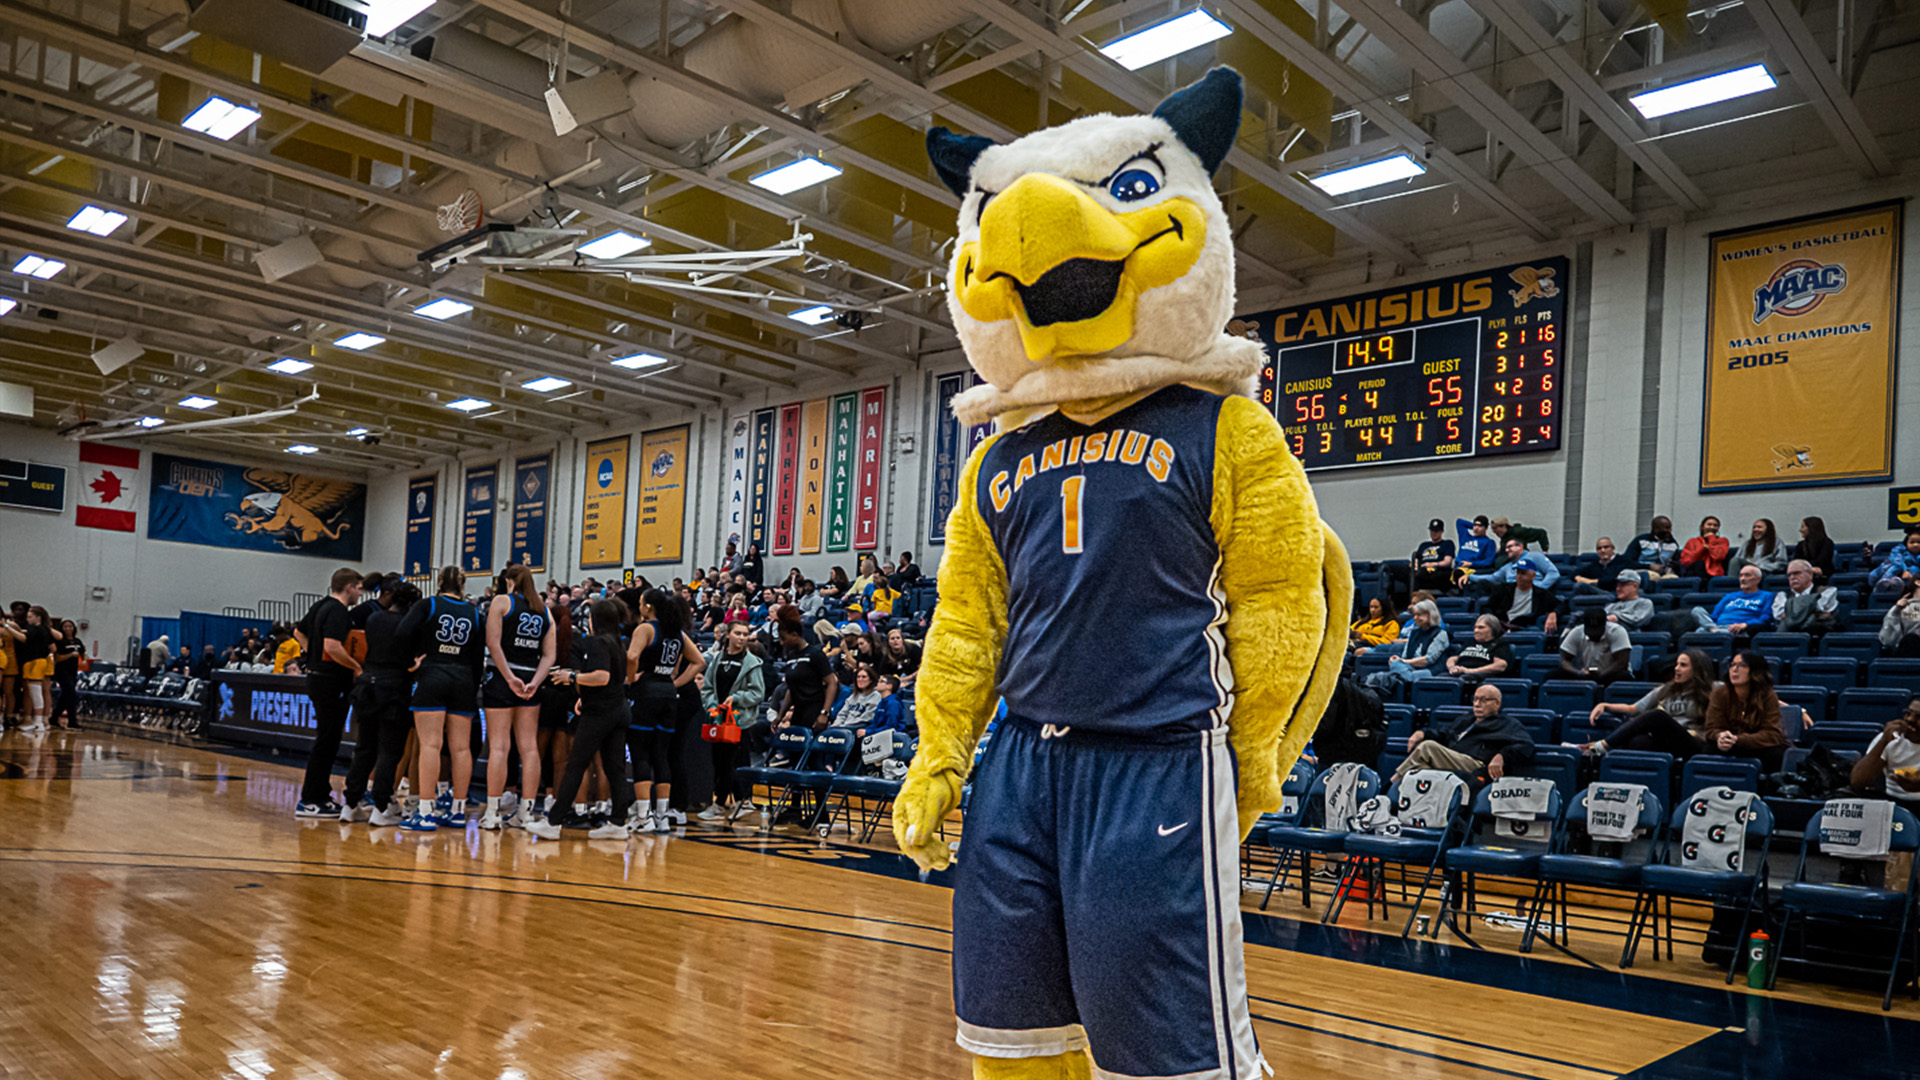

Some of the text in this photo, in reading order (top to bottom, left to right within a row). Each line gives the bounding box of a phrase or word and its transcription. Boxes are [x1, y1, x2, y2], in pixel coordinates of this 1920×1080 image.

[1721, 226, 1888, 262] WOMEN'S BASKETBALL
[1754, 264, 1847, 325] MAAC
[1274, 277, 1493, 344] CANISIUS
[1514, 314, 1527, 325] FLS
[1537, 310, 1552, 321] PTS
[1496, 331, 1508, 349] 2
[1537, 323, 1555, 342] 16
[1728, 322, 1872, 349] MAAC CHAMPIONS
[1423, 358, 1461, 375] GUEST
[1496, 356, 1507, 373] 3
[1542, 349, 1554, 367] 5
[1728, 350, 1789, 371] 2005
[1285, 377, 1333, 394] CANISIUS
[1358, 379, 1386, 390] PERIOD
[1428, 375, 1462, 406] 55
[1494, 374, 1553, 395] 4 2 6
[1295, 393, 1326, 422] 56
[1364, 390, 1379, 410] 4
[1481, 404, 1505, 423] 20
[1540, 399, 1552, 416] 8
[1345, 415, 1397, 429] PLAYER FOUL
[1437, 407, 1464, 418] FOULS
[1284, 425, 1308, 435] FOULS
[1446, 418, 1460, 440] 5
[1480, 425, 1551, 447] 22 3 4
[1293, 432, 1331, 455] 3 3
[1435, 444, 1462, 455] SCORE
[863, 401, 879, 534] MARIST
[1356, 452, 1382, 462] MATCH
[753, 423, 768, 540] CANISIUS
[779, 411, 794, 546] FAIRFIELD
[806, 435, 818, 516] IONA
[833, 401, 850, 542] MANHATTAN
[989, 429, 1175, 513] CANISIUS
[31, 481, 55, 491] GUEST
[732, 447, 744, 524] MAAC
[1061, 475, 1086, 554] 1
[435, 614, 472, 645] 33
[517, 612, 543, 638] 23
[660, 638, 681, 664] 13
[1690, 798, 1708, 817] G
[1707, 824, 1727, 844] G
[1683, 841, 1699, 860] G
[1750, 947, 1763, 961] G
